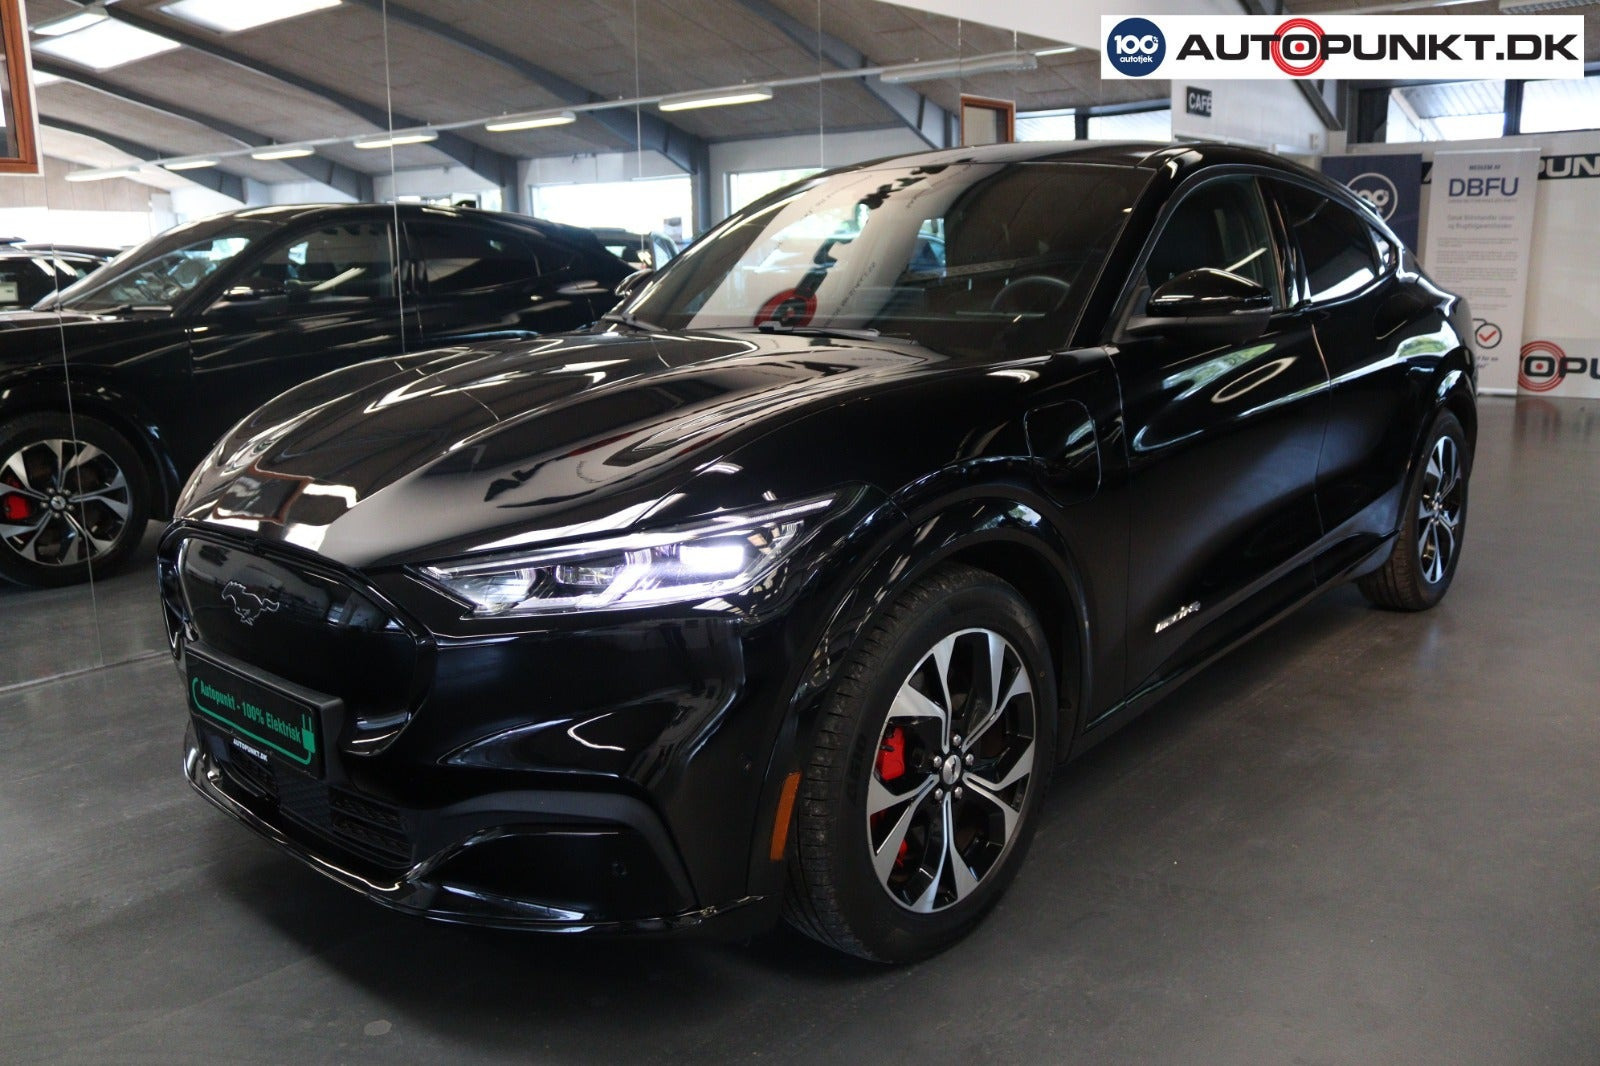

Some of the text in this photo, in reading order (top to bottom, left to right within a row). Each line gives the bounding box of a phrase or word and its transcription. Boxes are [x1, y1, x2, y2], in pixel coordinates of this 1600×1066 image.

[1448, 177, 1519, 197] DBFU
[200, 680, 236, 712] Autopunkt
[242, 701, 265, 725] 100%
[266, 711, 302, 744] Elektrisk
[233, 737, 269, 762] AUTOPUNKT.DK
